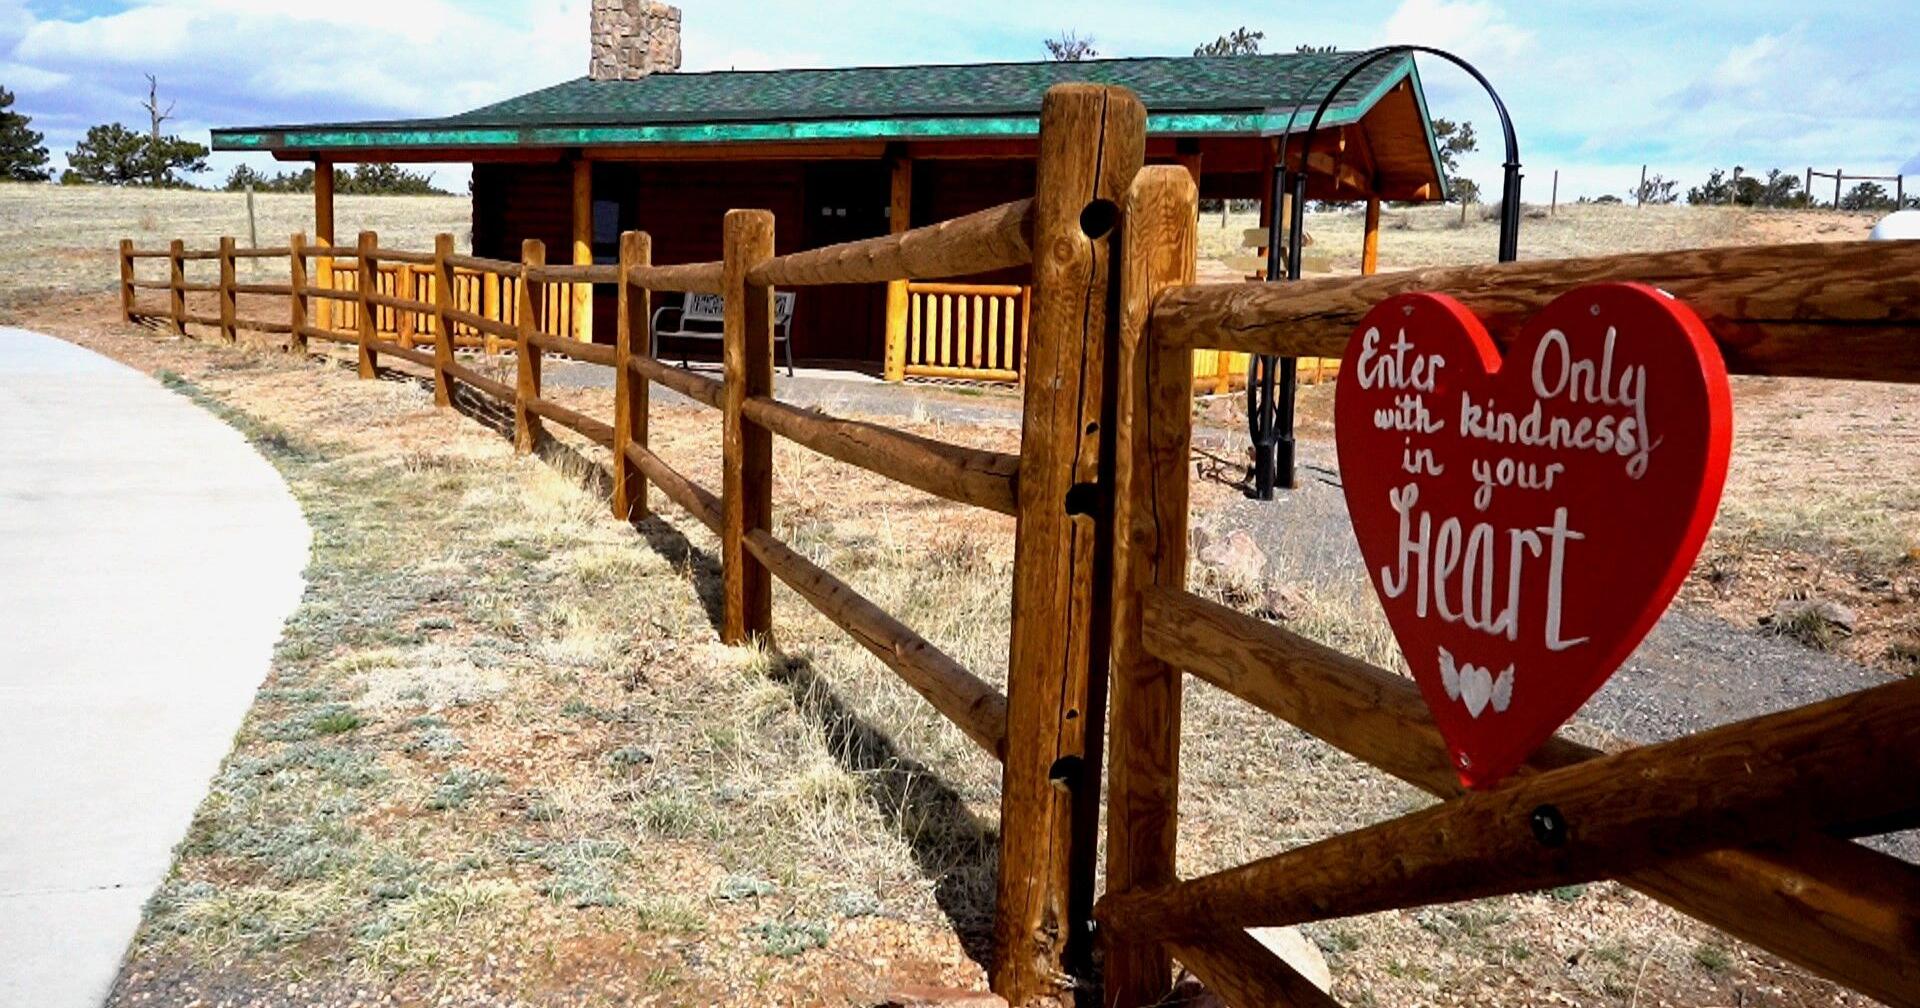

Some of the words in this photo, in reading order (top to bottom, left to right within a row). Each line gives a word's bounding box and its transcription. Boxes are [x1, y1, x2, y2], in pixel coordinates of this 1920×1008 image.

[1357, 326, 1445, 391] Enter
[1532, 325, 1663, 479] Only
[1374, 395, 1444, 432] with
[1460, 390, 1638, 455] kindness
[1401, 436, 1444, 476] in
[1471, 456, 1565, 511] your
[1381, 482, 1590, 650] Heart
